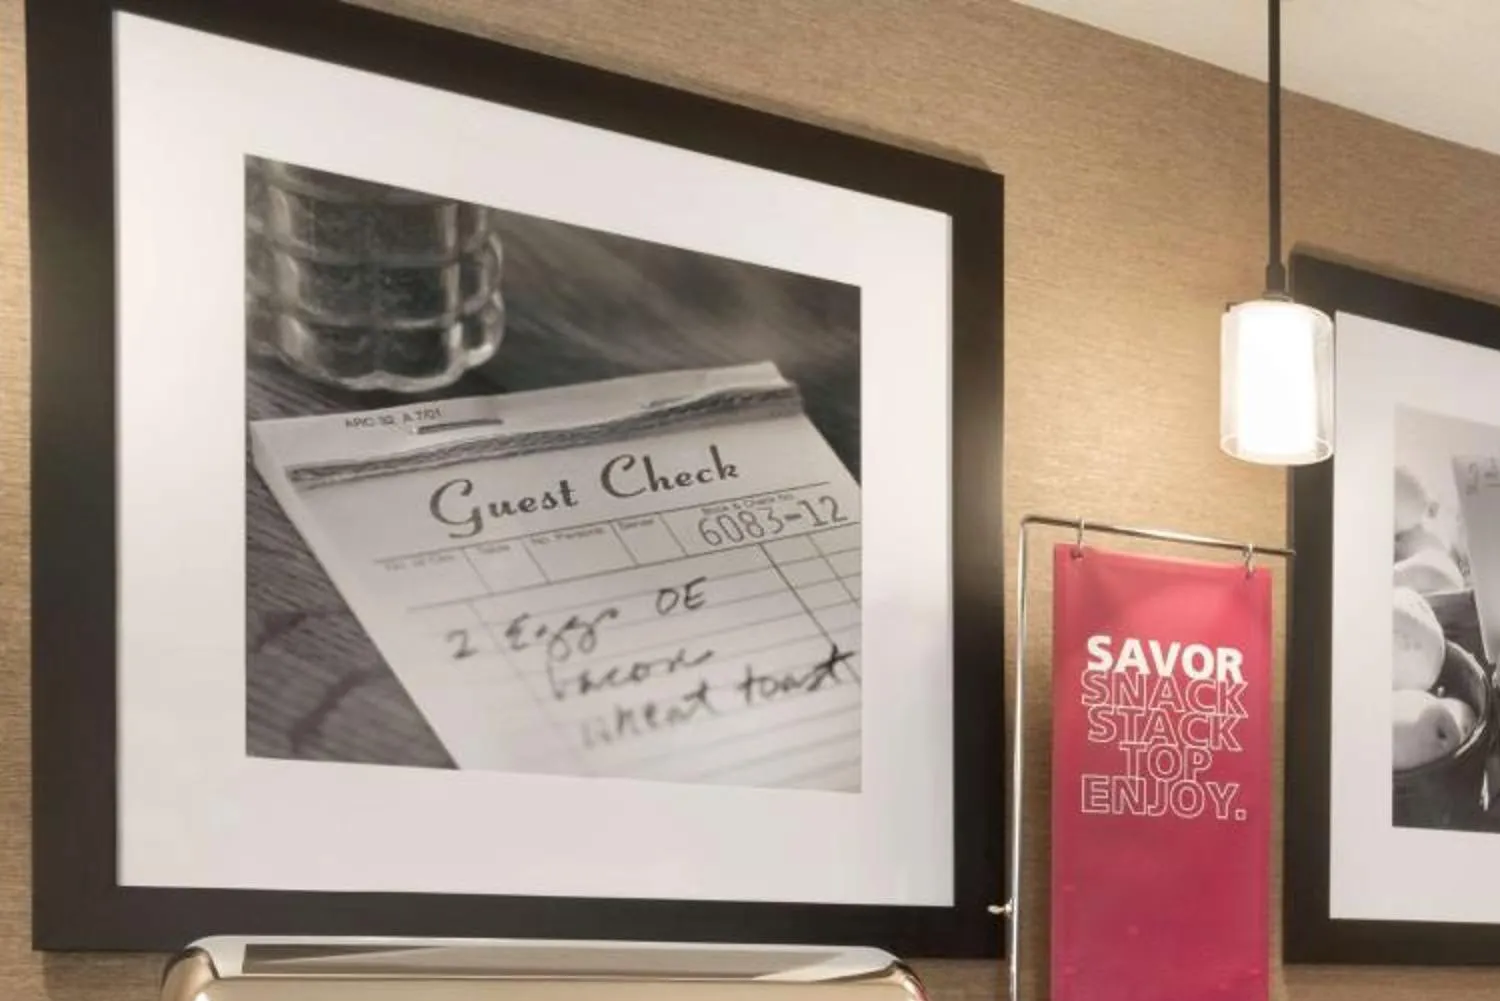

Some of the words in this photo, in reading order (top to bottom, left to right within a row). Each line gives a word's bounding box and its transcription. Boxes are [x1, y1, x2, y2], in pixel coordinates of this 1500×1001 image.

[430, 479, 578, 537] Guest
[600, 446, 740, 498] Check
[699, 496, 848, 546] 6083-12
[446, 628, 477, 660] 2
[655, 576, 708, 616] OE
[1087, 635, 1244, 684] SAVOR
[1080, 669, 1249, 719] SNACK
[1087, 704, 1243, 752] STACK
[1118, 741, 1213, 783] TOP
[1080, 774, 1248, 821] ENJOY.
